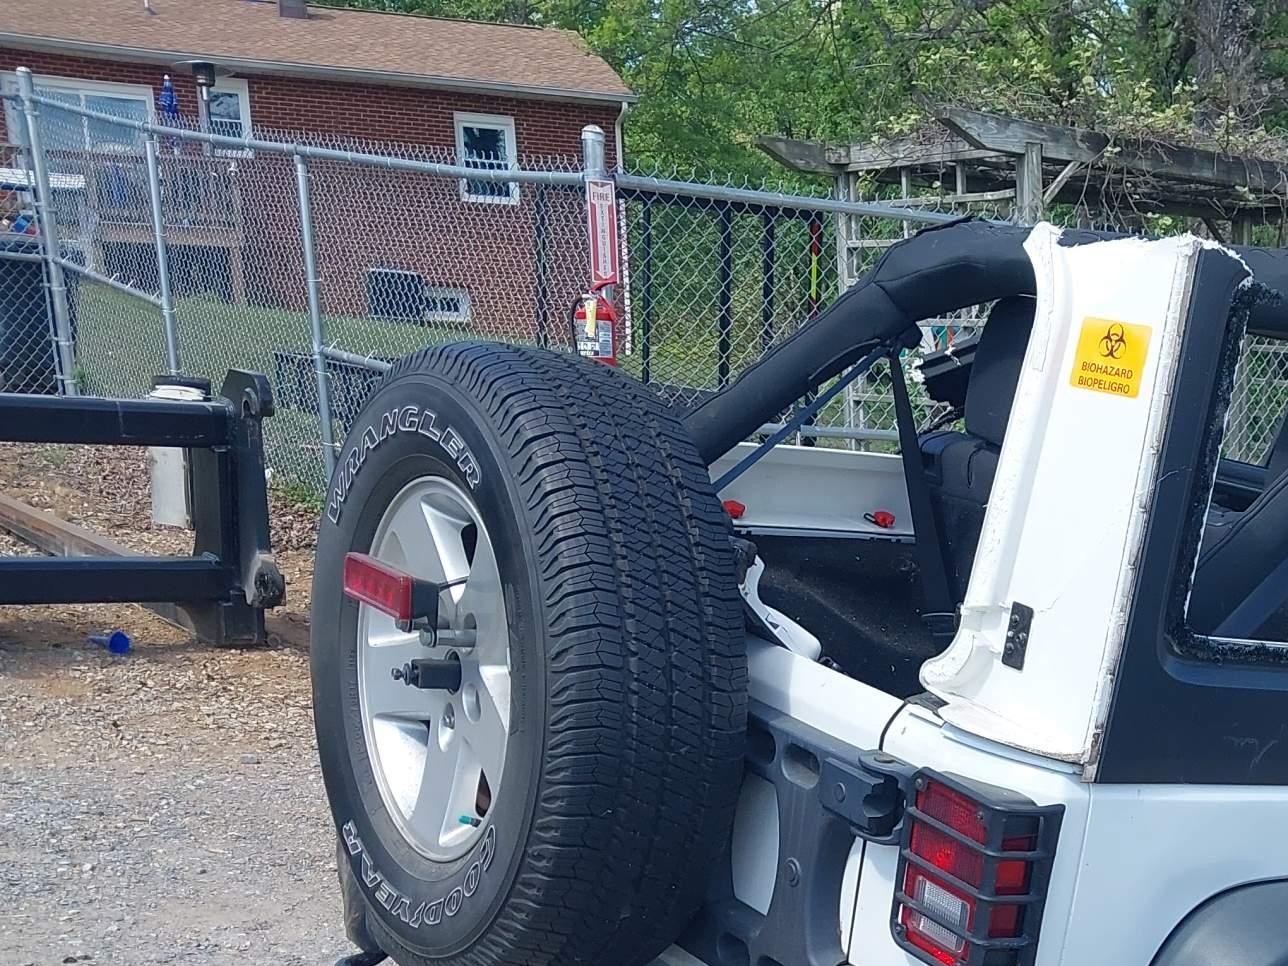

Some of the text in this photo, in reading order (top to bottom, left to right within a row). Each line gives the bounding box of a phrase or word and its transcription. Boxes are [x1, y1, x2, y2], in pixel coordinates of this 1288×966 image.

[592, 191, 610, 202] FIRE
[1081, 361, 1134, 380] BIOHAZARD
[1077, 375, 1131, 395] BIOPELIGRO
[327, 404, 482, 524] WRANGLER
[342, 819, 497, 929] GOODYEAR
